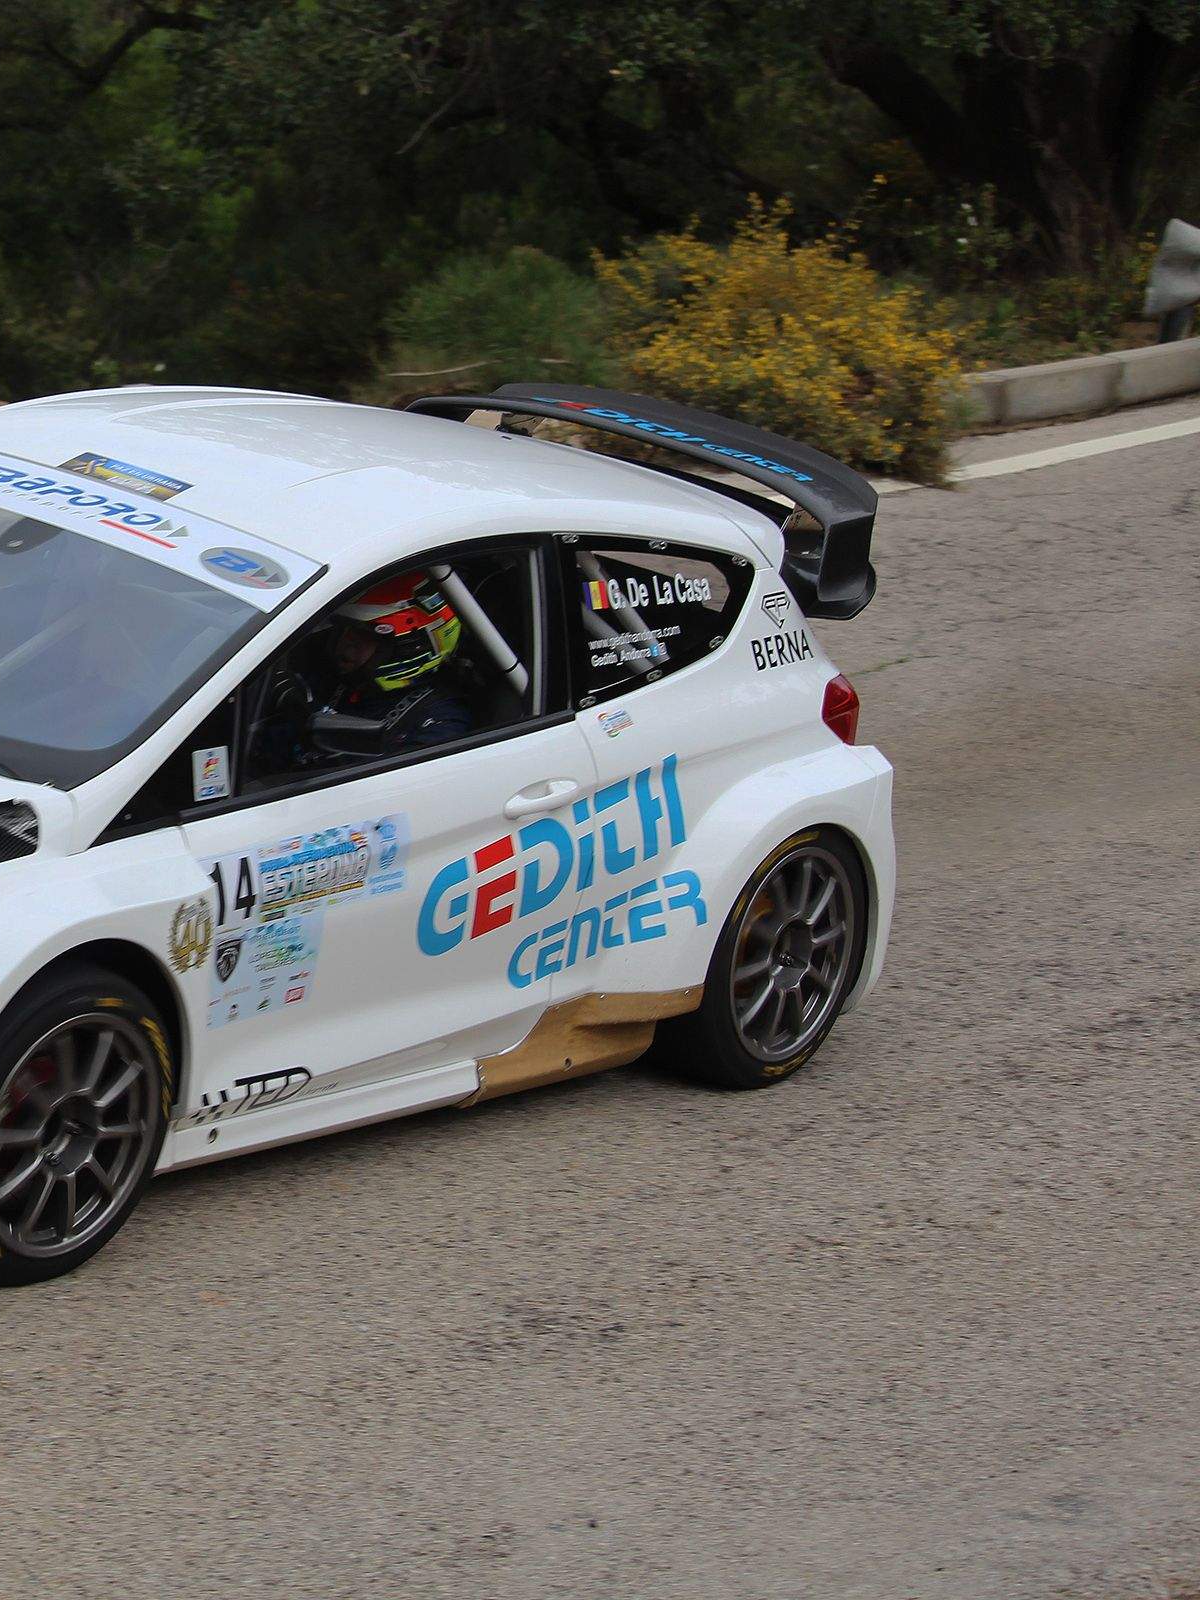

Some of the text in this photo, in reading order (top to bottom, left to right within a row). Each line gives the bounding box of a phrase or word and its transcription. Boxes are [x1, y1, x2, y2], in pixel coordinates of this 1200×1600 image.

[607, 572, 712, 610] G. De La Casa
[751, 629, 814, 671] BERNA
[207, 855, 257, 927] 14
